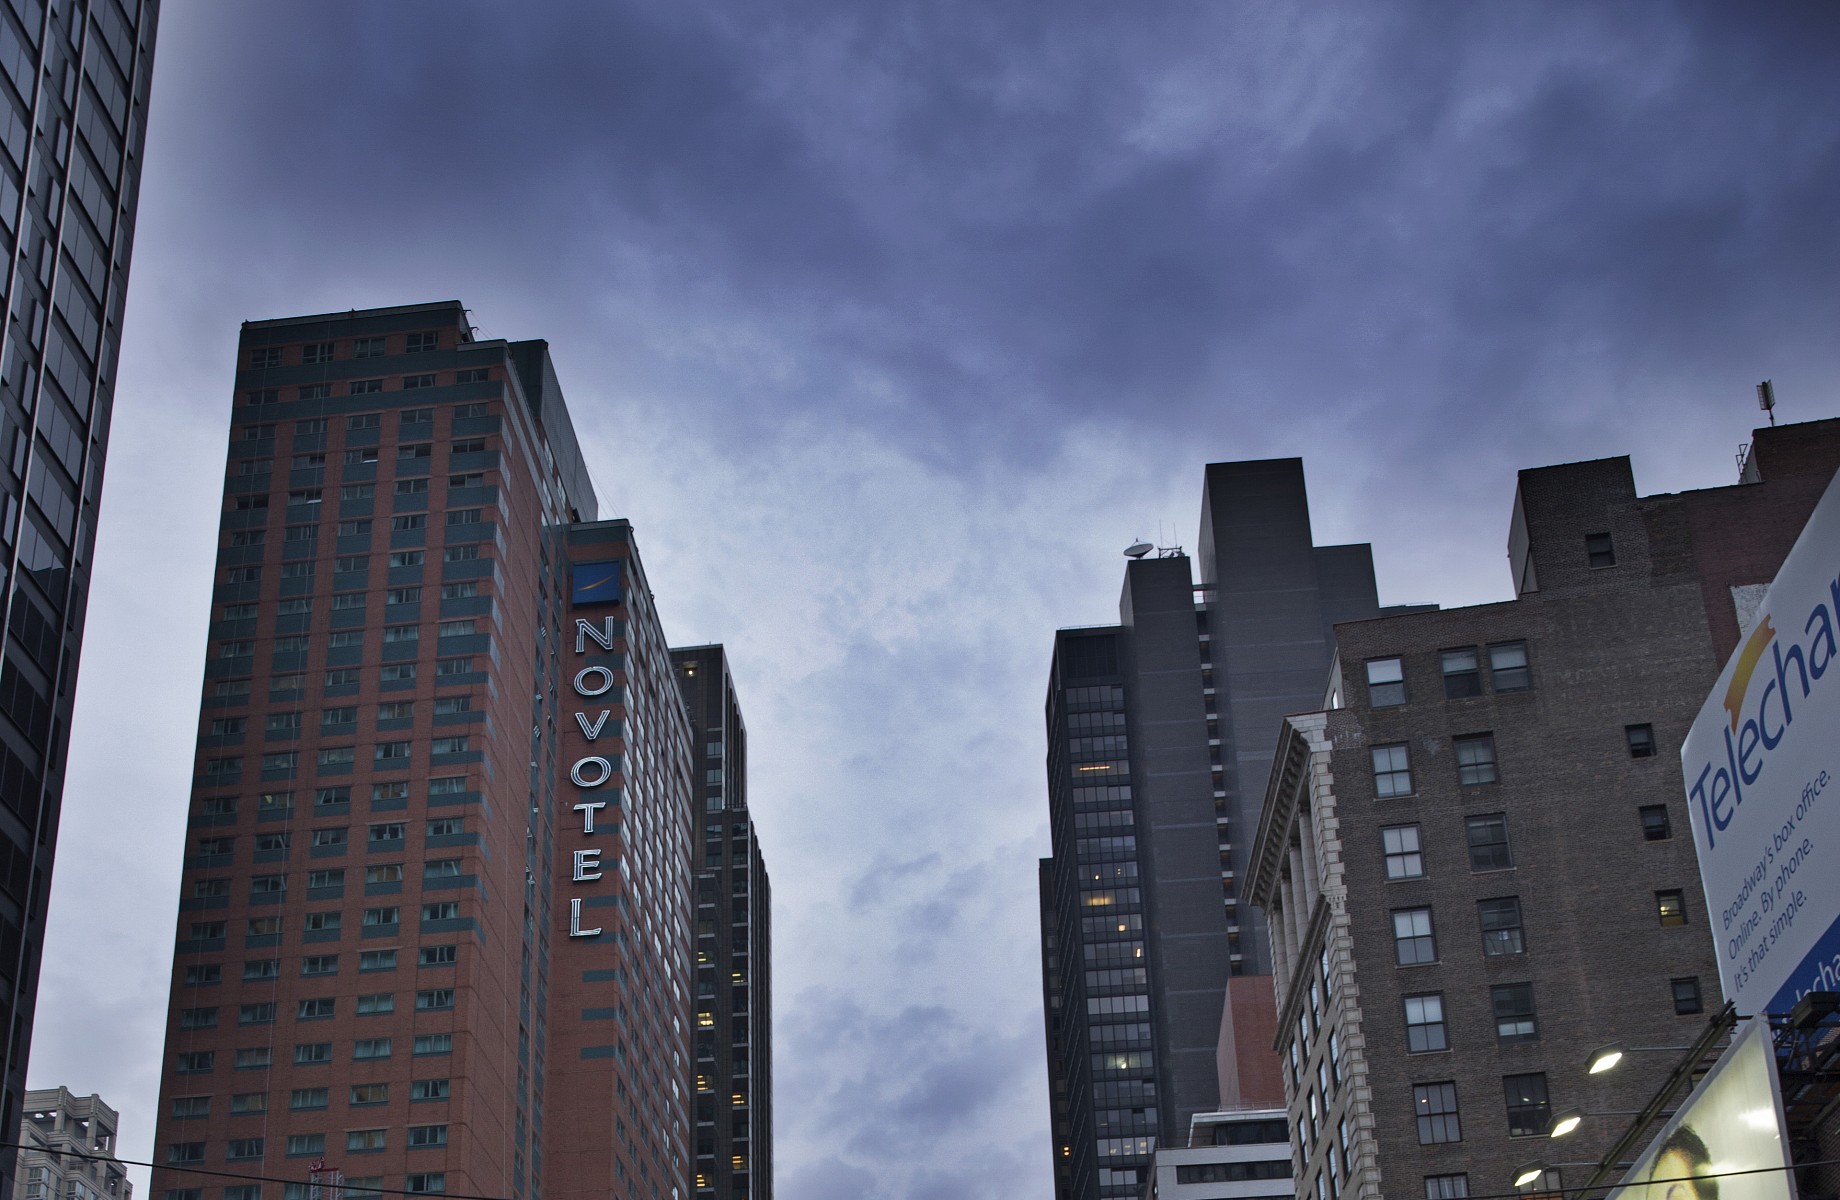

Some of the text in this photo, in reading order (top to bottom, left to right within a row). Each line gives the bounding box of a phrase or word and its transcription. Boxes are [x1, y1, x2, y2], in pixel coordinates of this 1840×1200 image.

[570, 616, 614, 937] NOVOTEL
[1722, 769, 1831, 931] Broadway's box office.
[1728, 837, 1814, 960] Online. By phone.
[1734, 888, 1807, 992] It's that simple.
